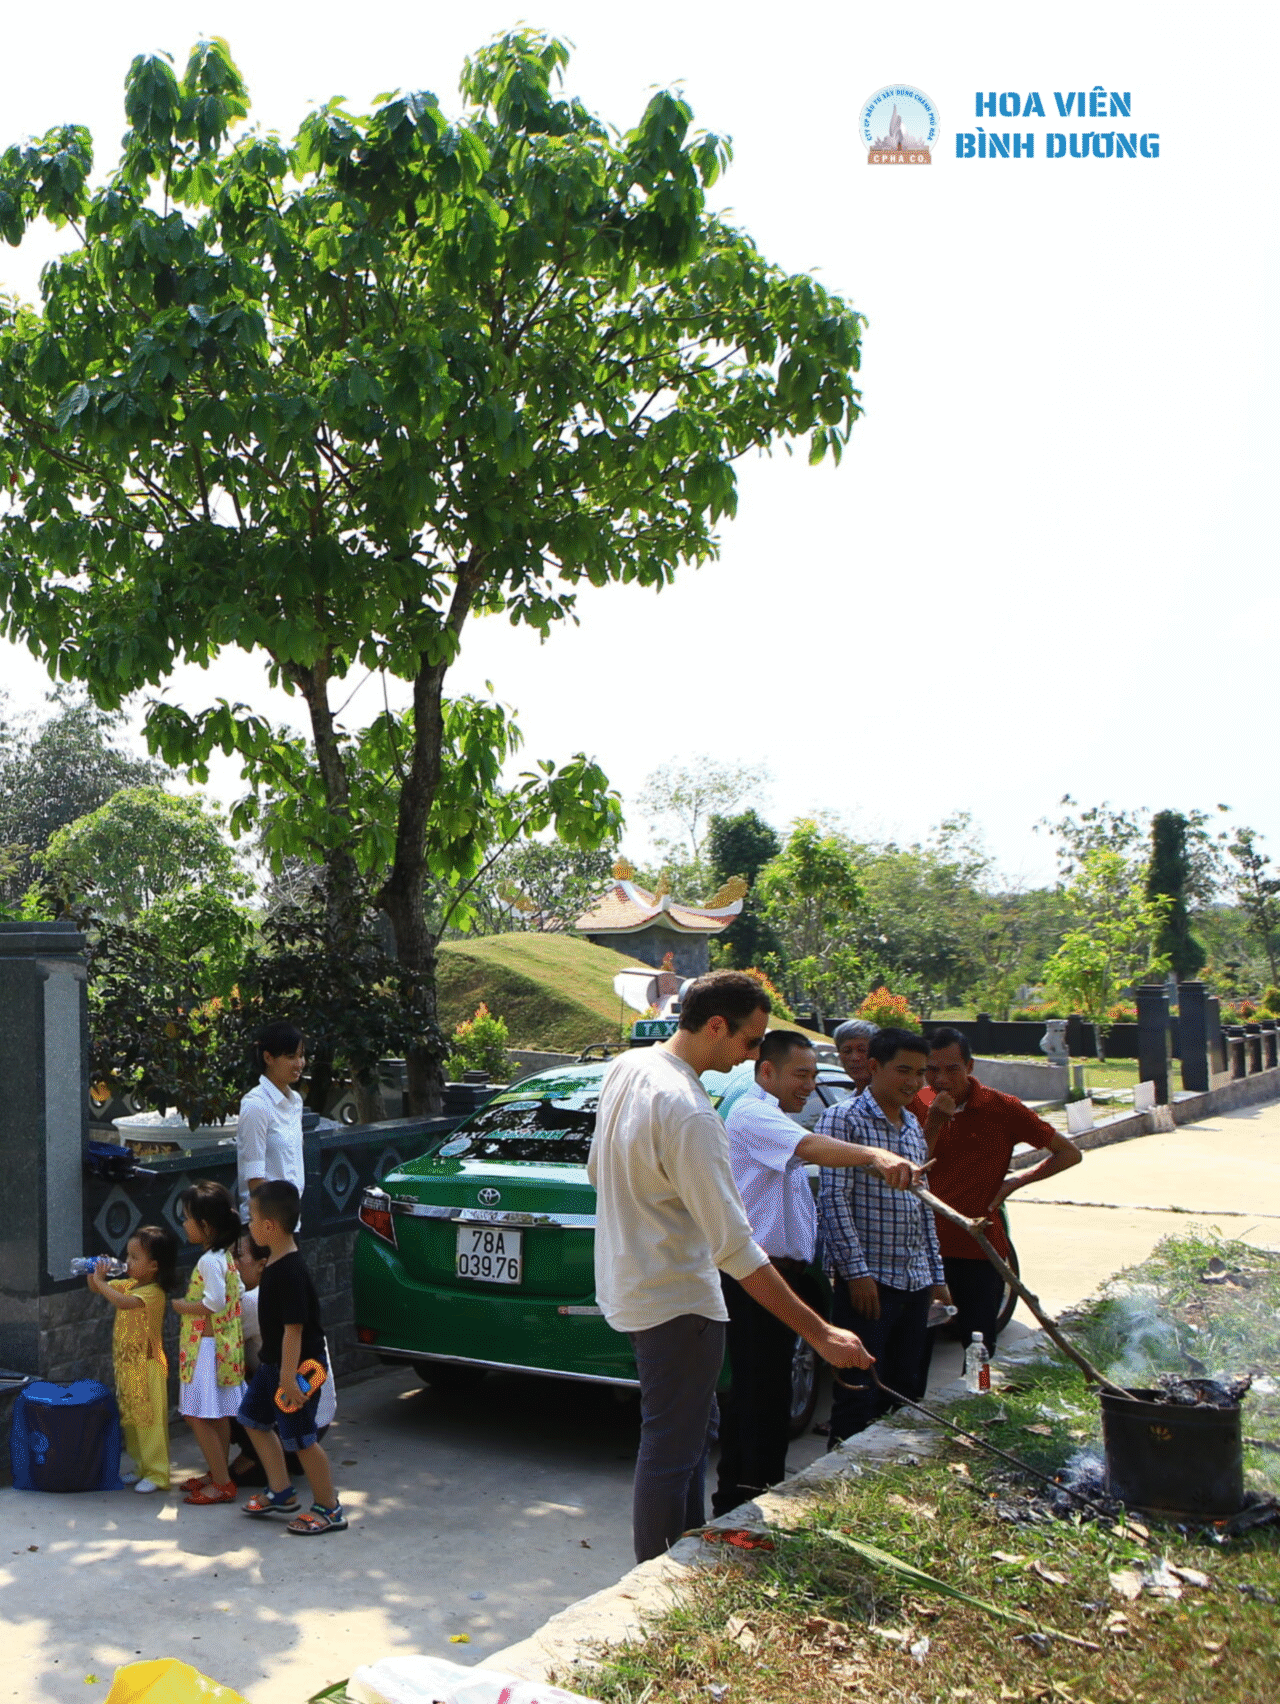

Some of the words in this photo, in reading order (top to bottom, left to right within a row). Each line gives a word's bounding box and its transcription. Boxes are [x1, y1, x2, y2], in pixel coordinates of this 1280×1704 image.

[644, 1023, 676, 1036] TAX
[472, 1230, 505, 1255] 78A
[459, 1253, 518, 1280] 039.76
